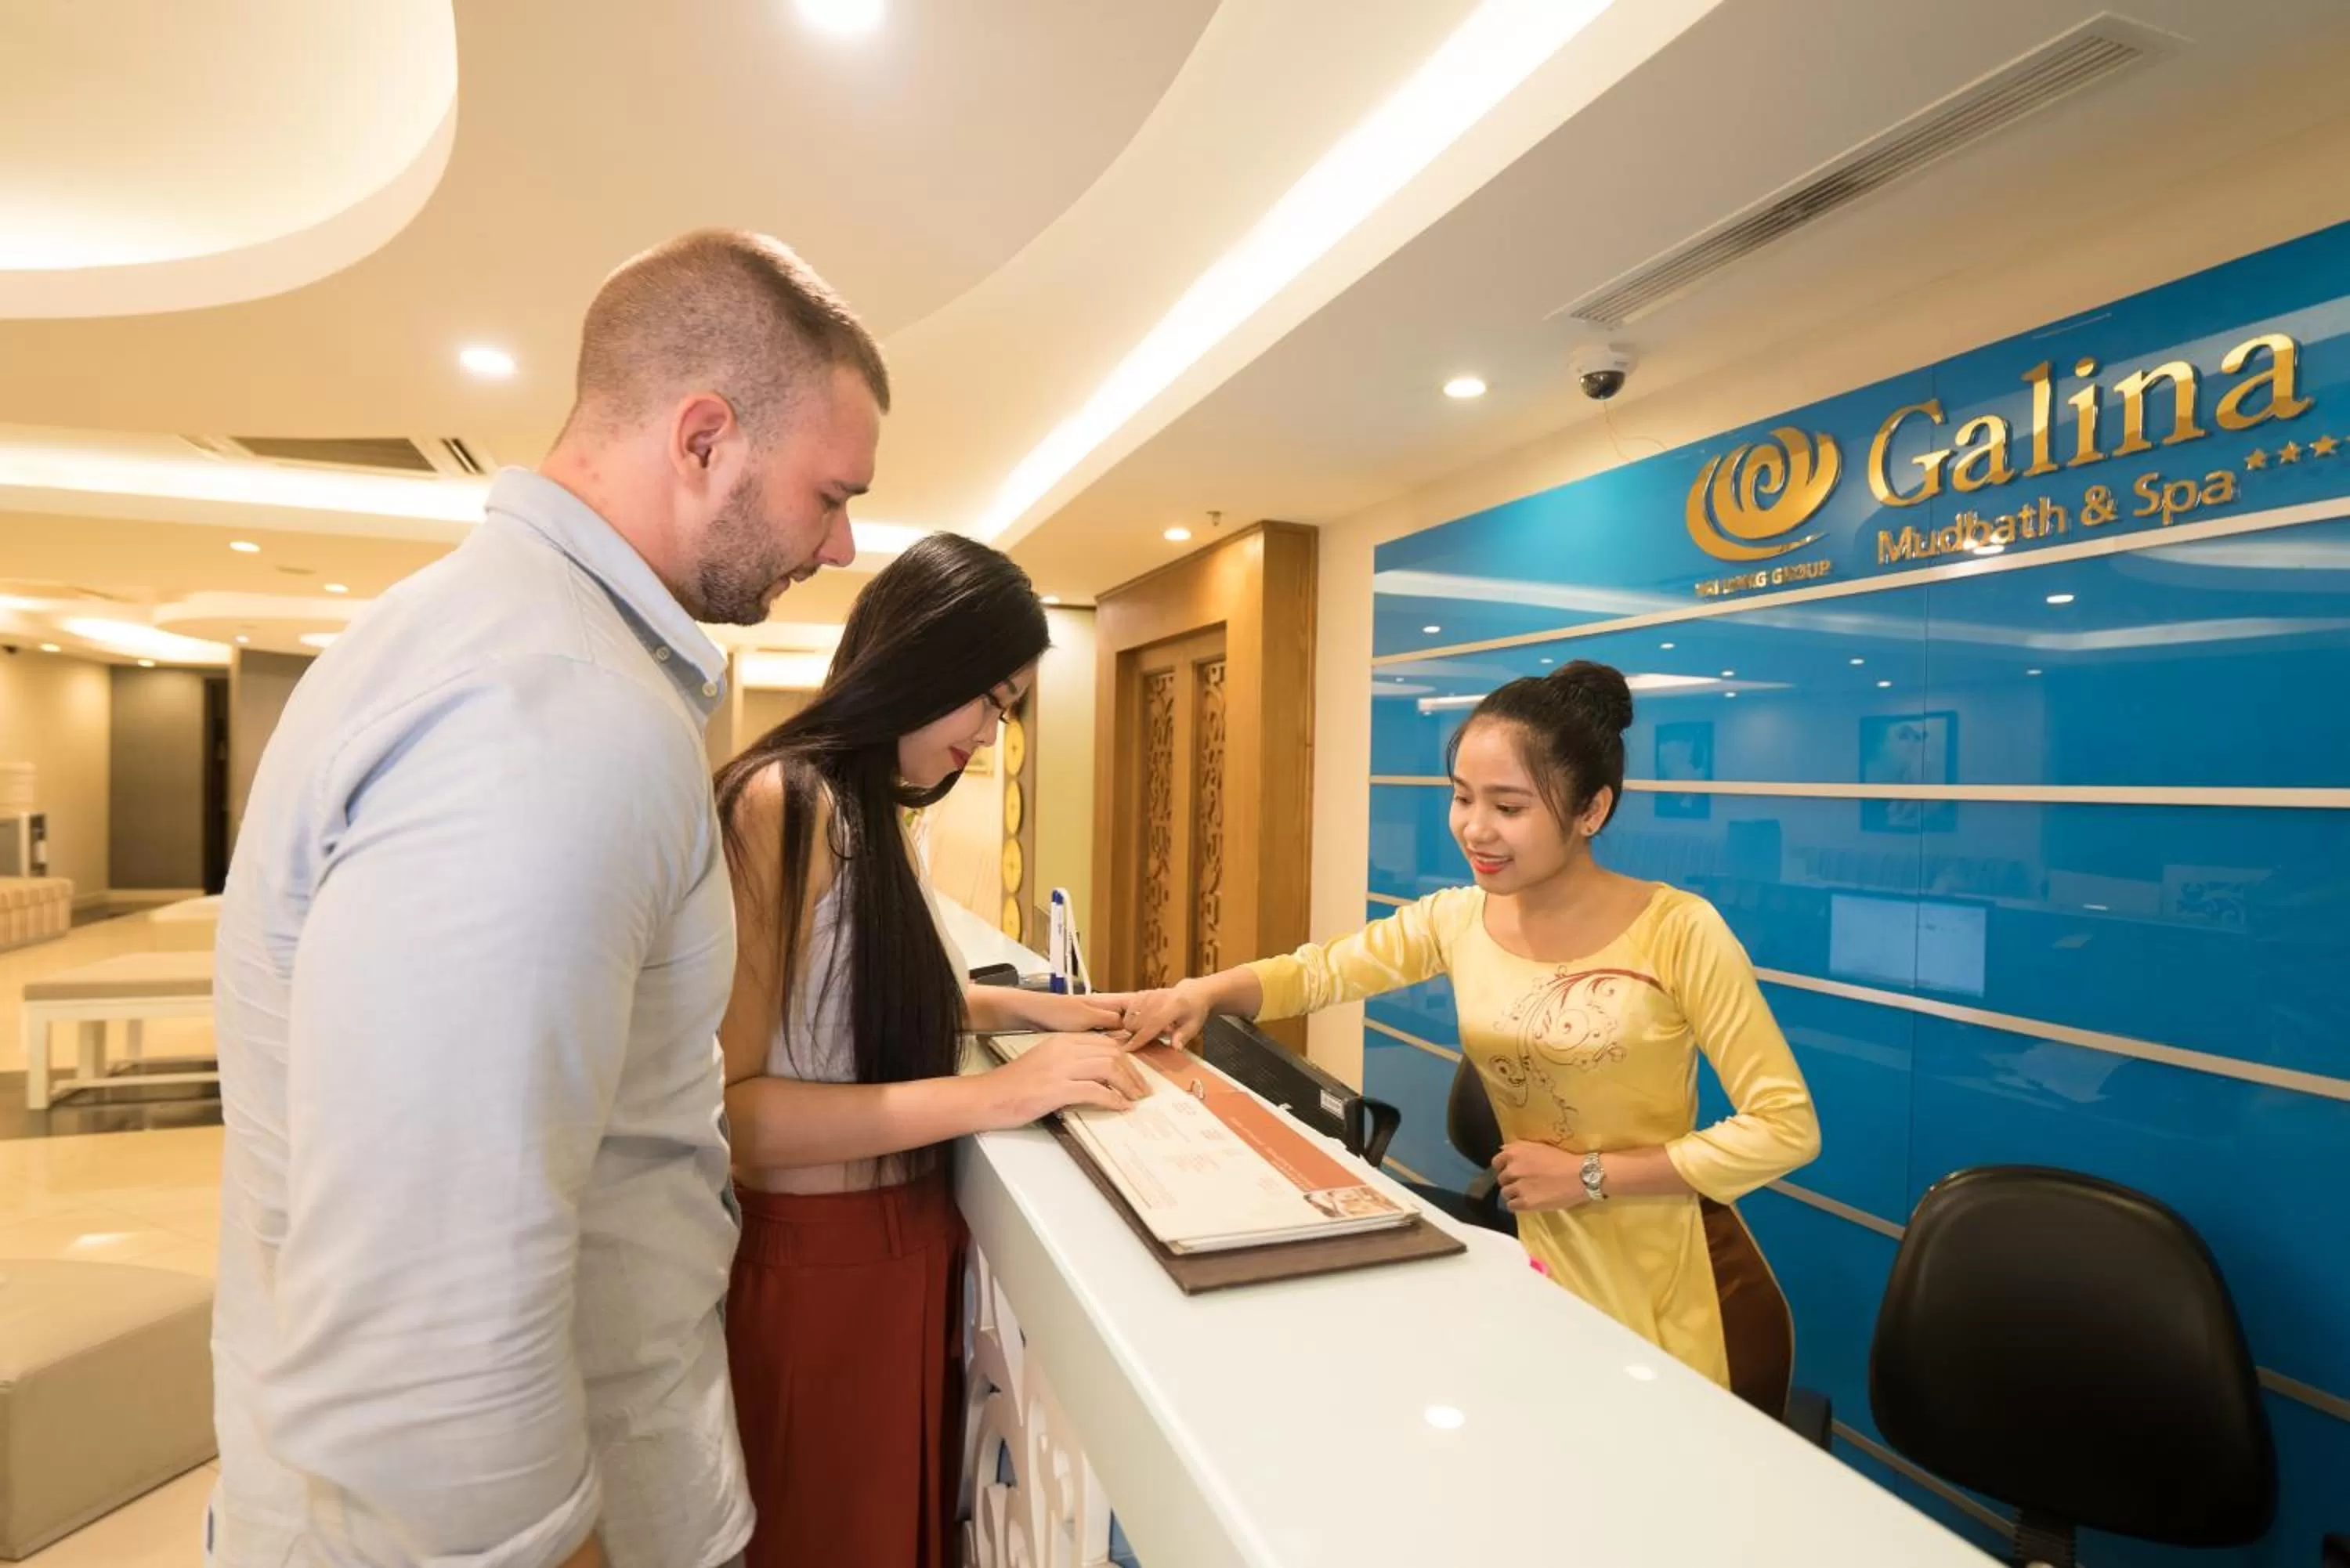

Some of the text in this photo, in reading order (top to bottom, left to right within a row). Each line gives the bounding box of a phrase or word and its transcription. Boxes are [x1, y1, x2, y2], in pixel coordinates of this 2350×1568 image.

[1868, 334, 2313, 507] Galina
[1878, 471, 2236, 564] Mudbath & Spa
